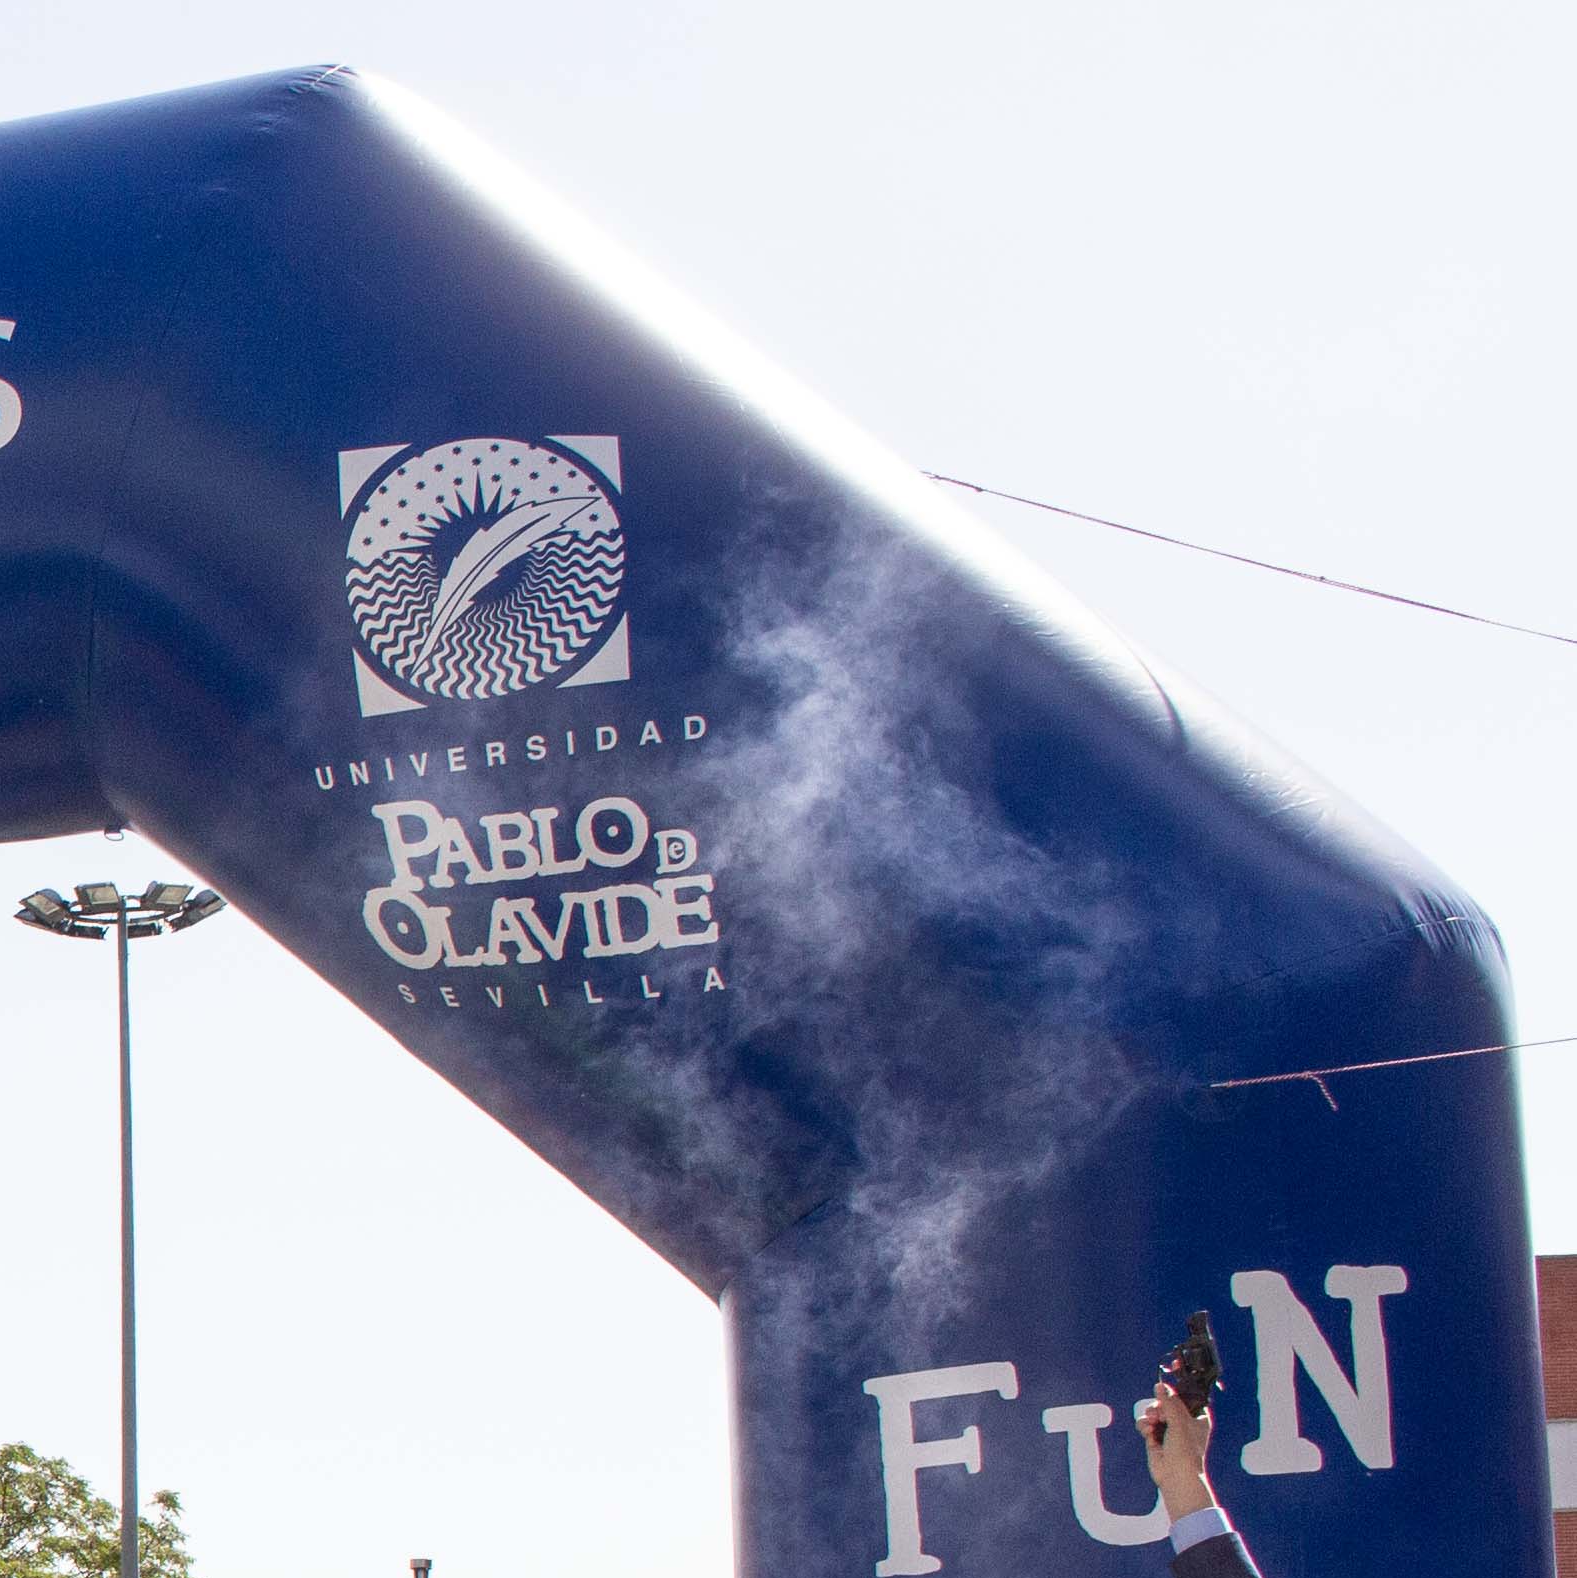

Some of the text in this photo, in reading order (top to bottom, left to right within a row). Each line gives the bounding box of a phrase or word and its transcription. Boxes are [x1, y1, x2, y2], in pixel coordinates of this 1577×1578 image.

[315, 714, 709, 791] UNIVERSIDAD
[371, 797, 649, 891] PABLO
[362, 875, 720, 970] OLAVIDE
[397, 966, 726, 1008] SEVILLA
